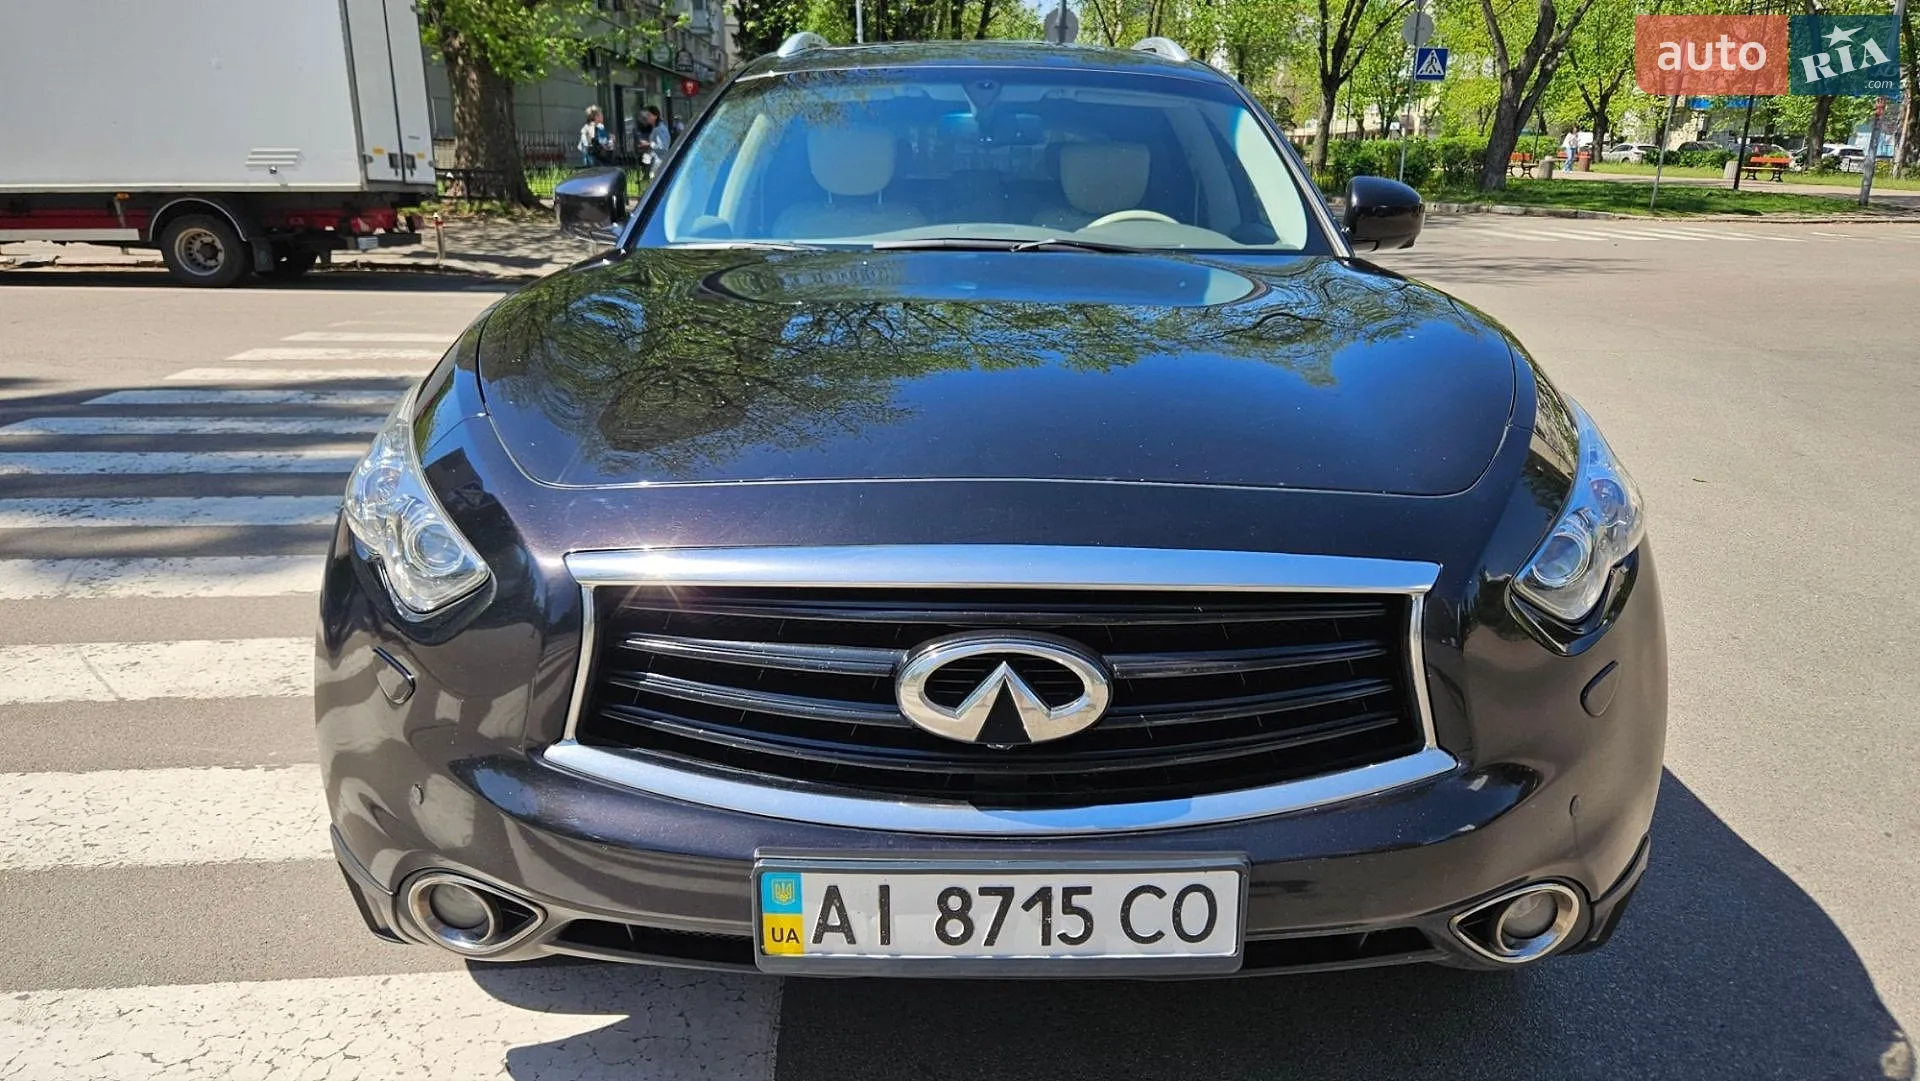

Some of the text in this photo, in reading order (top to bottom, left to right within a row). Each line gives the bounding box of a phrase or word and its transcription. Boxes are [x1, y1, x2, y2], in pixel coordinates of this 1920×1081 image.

[771, 926, 801, 945] UA
[811, 883, 1218, 947] AI 8715 CO
